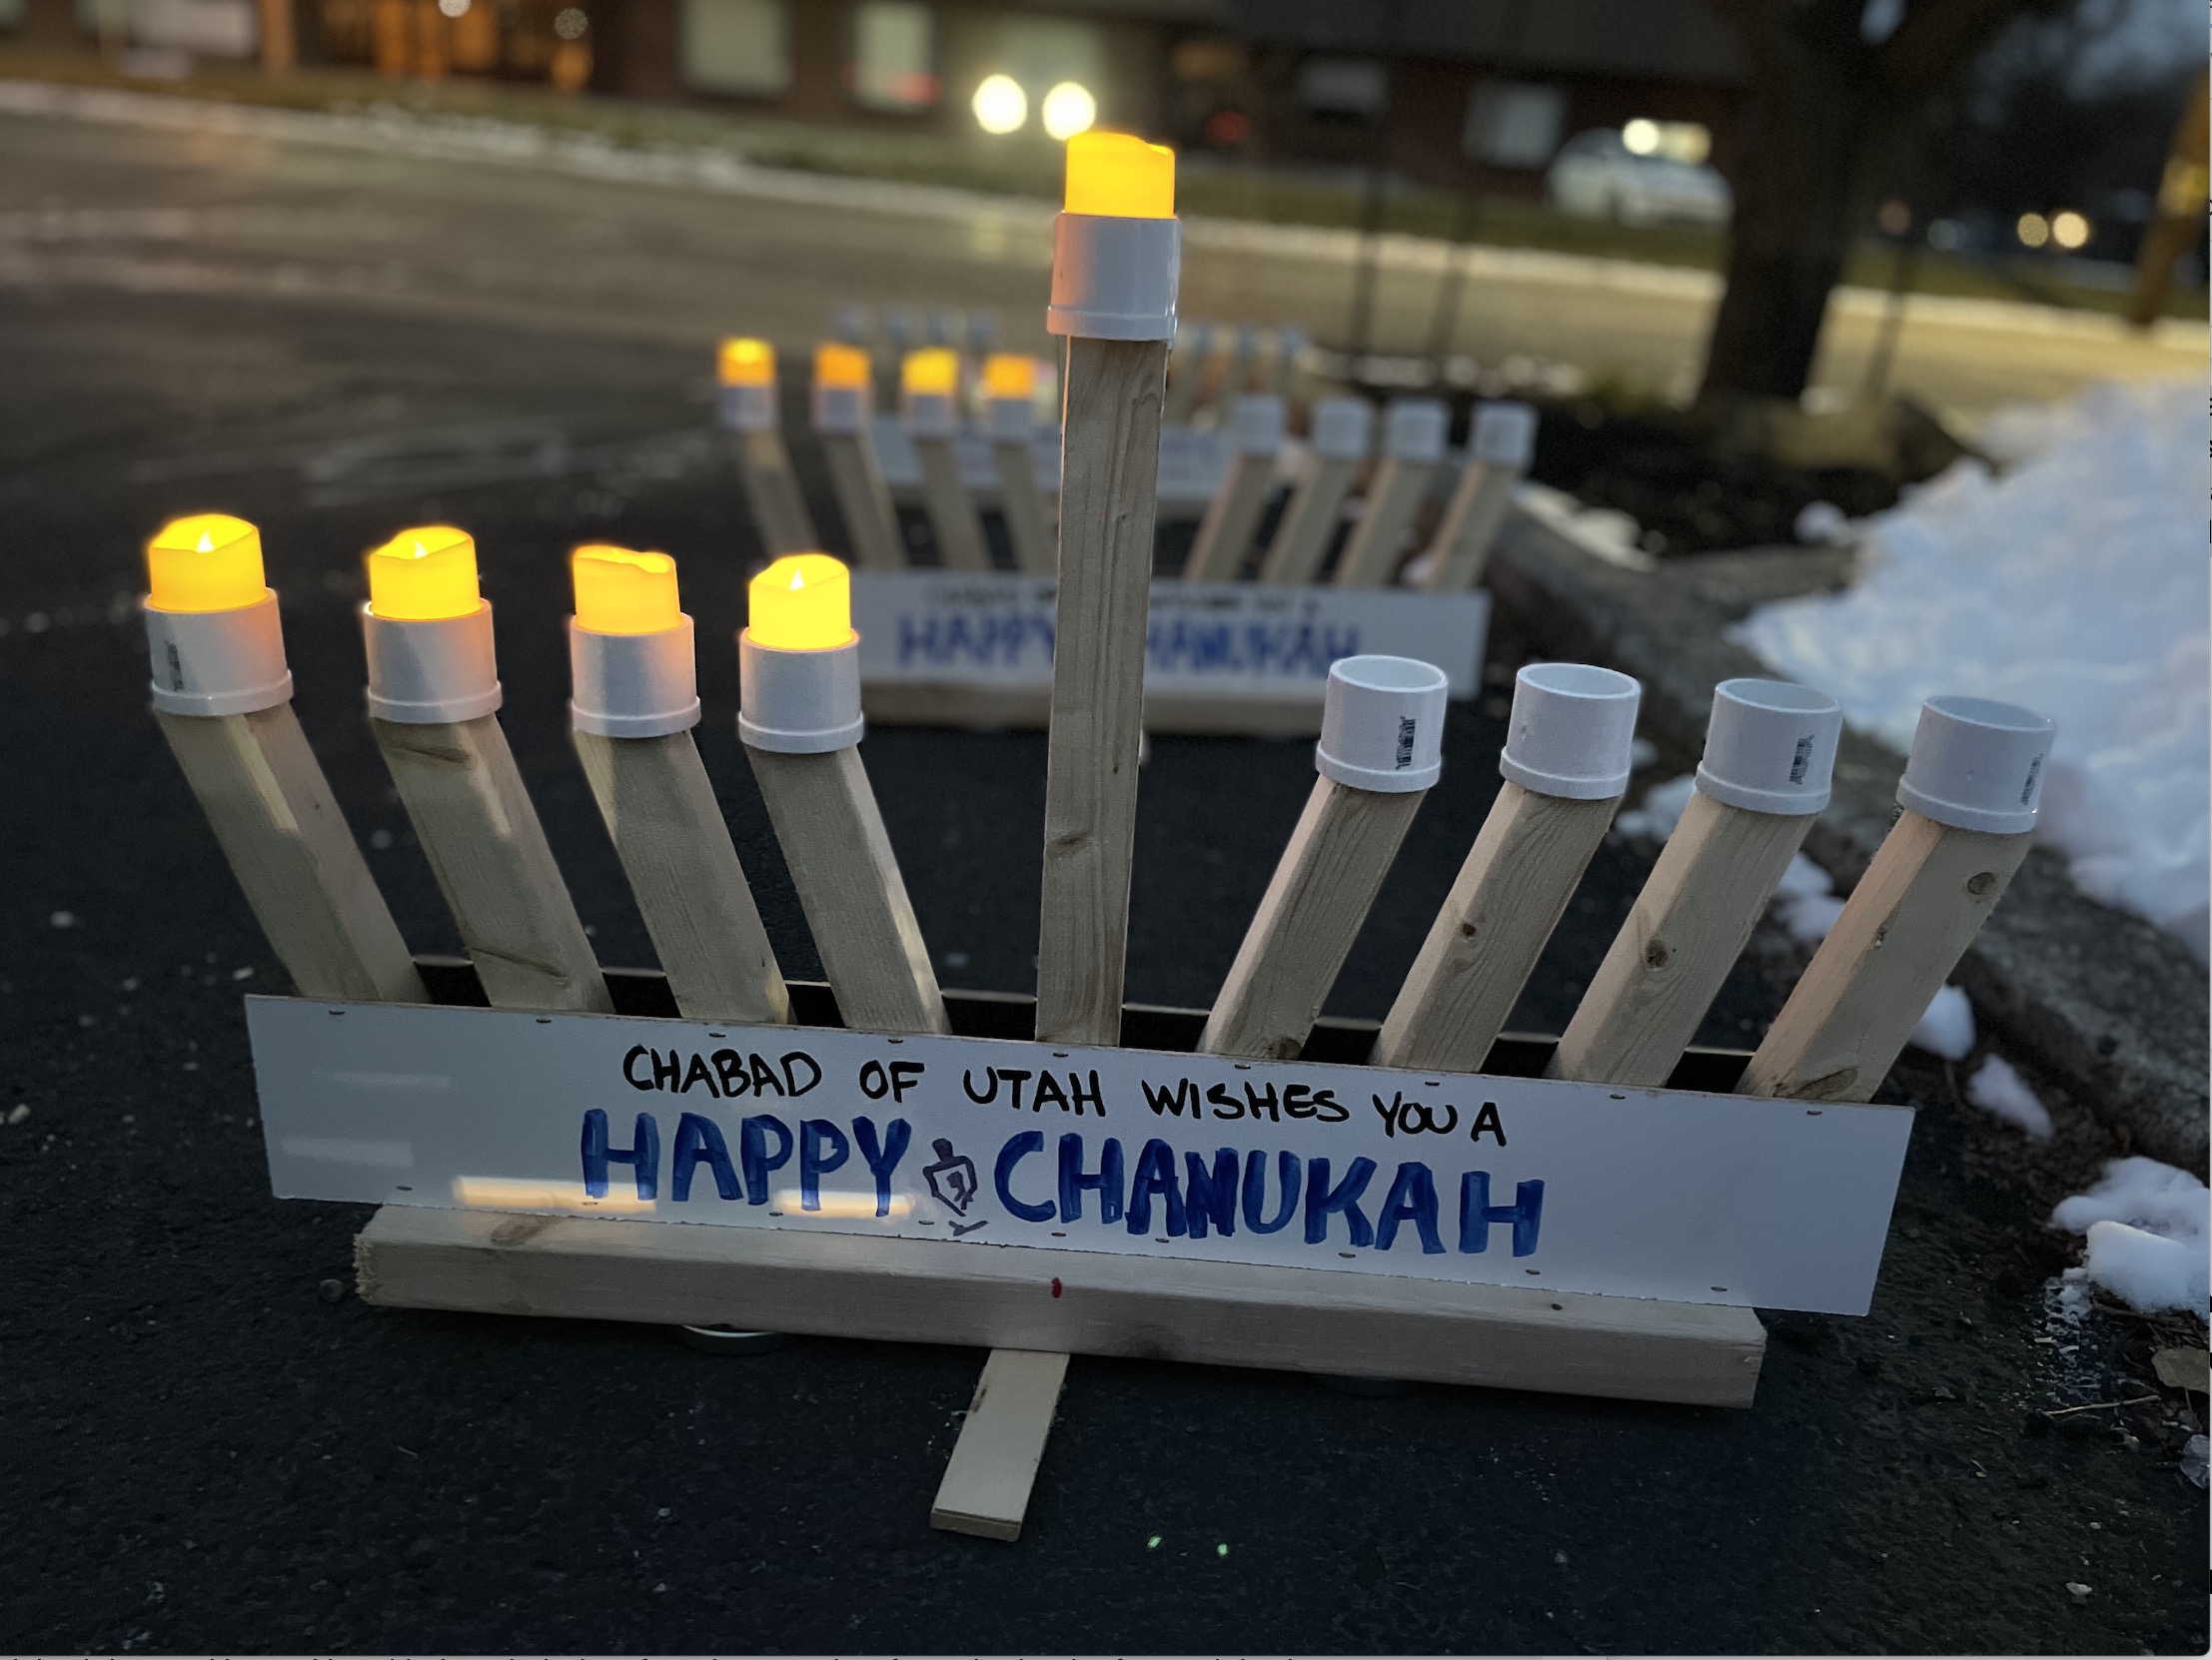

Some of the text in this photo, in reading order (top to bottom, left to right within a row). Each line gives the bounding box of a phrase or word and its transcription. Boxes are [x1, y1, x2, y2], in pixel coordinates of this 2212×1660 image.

[622, 1044, 1507, 1148] CHABAD OF UTAH WISHES YOU A
[580, 1108, 1546, 1257] HAPPY CHANUKAH
